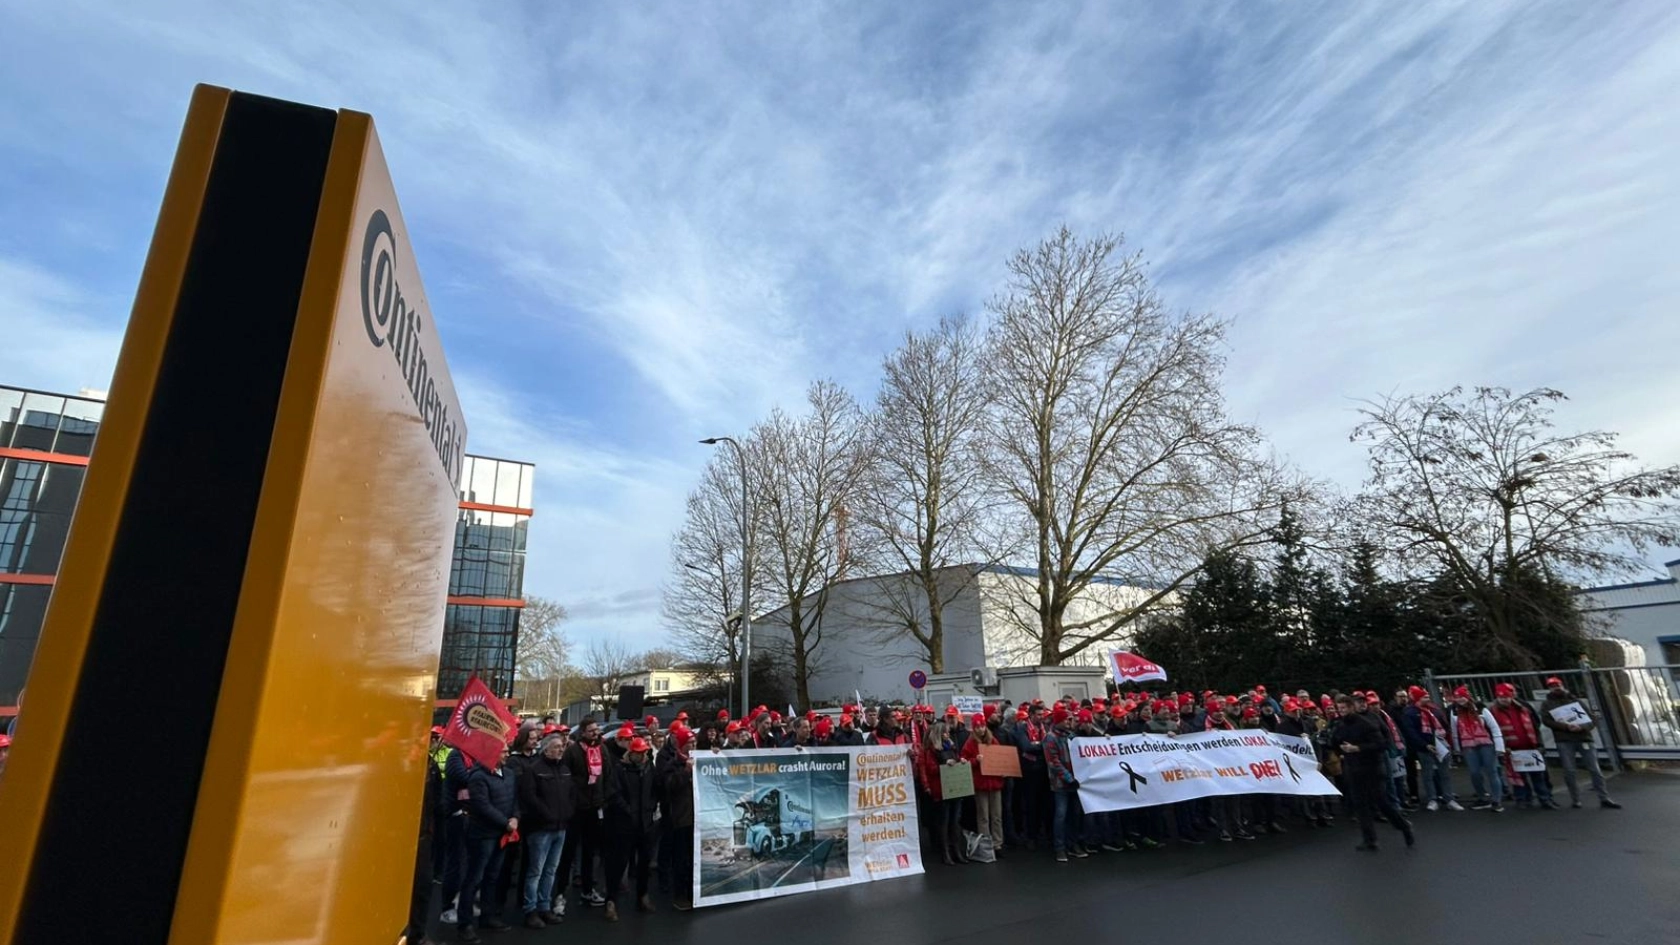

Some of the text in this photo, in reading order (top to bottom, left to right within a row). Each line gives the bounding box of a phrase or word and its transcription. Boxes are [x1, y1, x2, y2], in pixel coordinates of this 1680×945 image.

[360, 208, 458, 486] Continental
[1078, 743, 1117, 758] LOKALE
[1118, 740, 1201, 755] Entscheidungen
[1201, 736, 1242, 750] werden
[1240, 735, 1271, 748] LOKAL
[857, 752, 903, 767] Continental
[701, 760, 846, 776] Ohne WETZLAR crasht Aurora!
[857, 765, 907, 781] WETZLAR
[1215, 766, 1249, 778] WILL
[1249, 759, 1284, 781] DIE!
[858, 782, 908, 808] MUSS
[860, 811, 905, 827] erhalten
[862, 827, 906, 842] werden!
